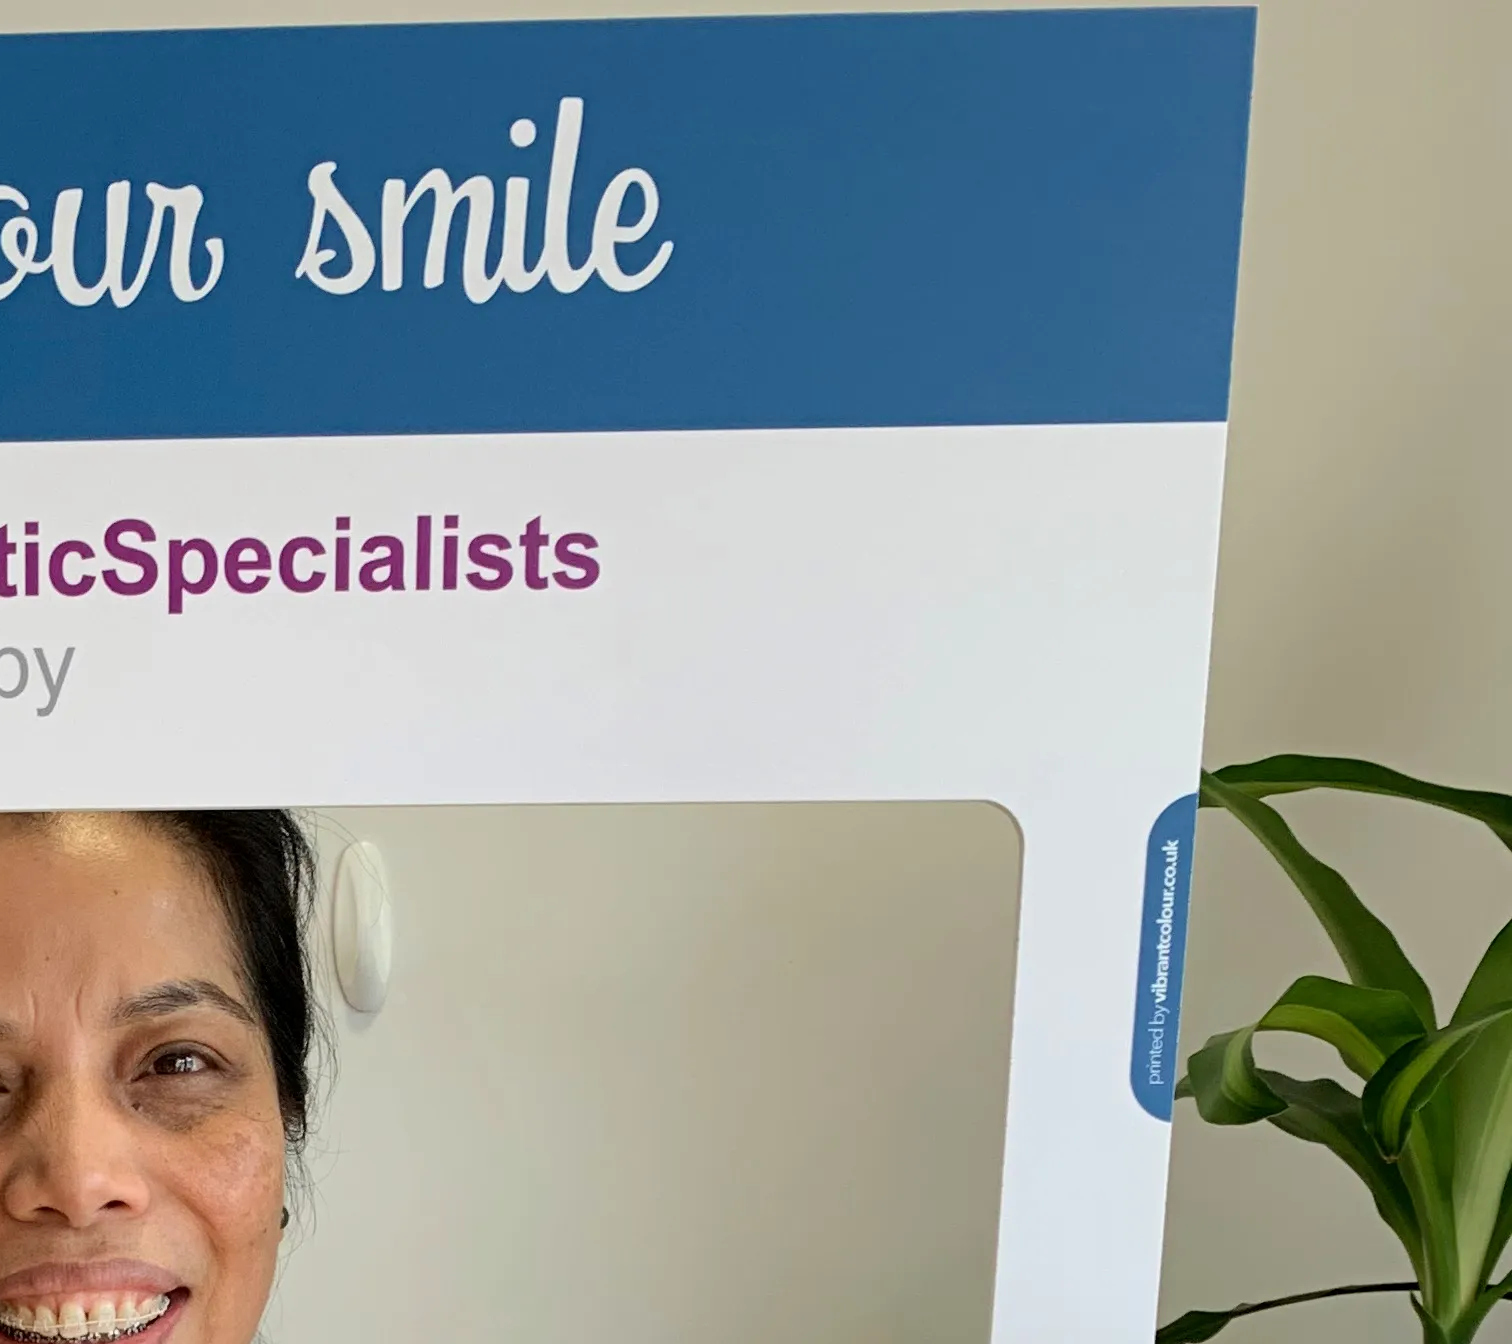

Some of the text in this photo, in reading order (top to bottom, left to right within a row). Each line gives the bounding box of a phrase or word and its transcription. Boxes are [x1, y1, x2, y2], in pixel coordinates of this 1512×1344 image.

[294, 95, 675, 304] smile
[1148, 838, 1179, 1086] printed by vibrantcolour.co.uk
